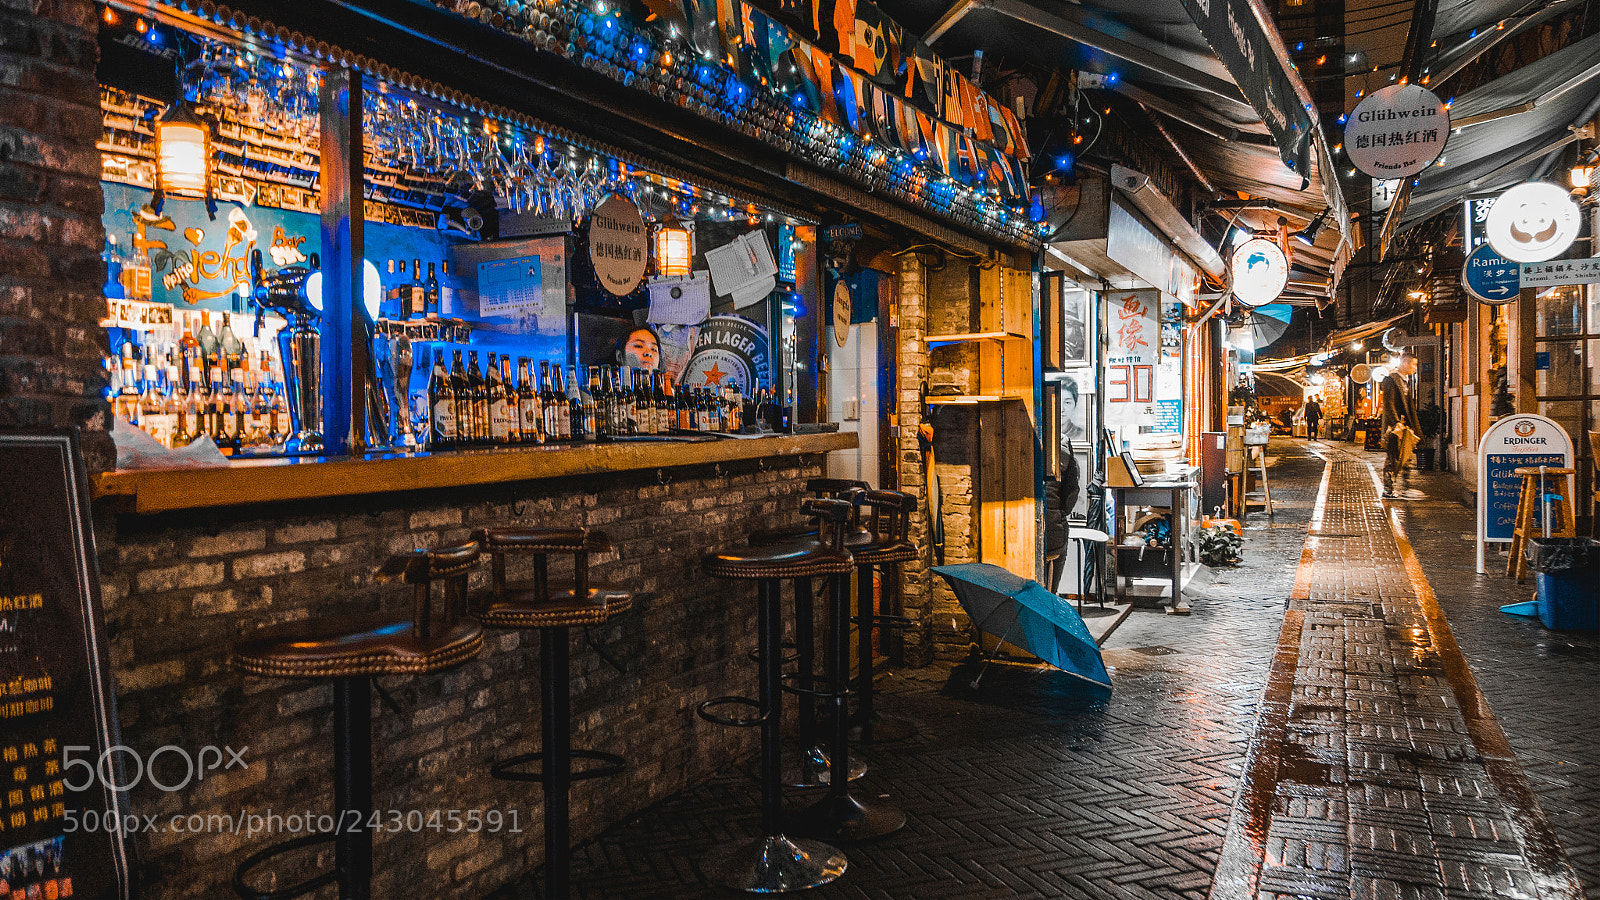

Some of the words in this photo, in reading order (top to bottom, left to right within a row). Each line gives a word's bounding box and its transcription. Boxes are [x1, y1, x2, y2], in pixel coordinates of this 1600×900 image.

[1357, 105, 1437, 123] Glühwein
[1355, 128, 1438, 149] 德国热红酒
[1373, 160, 1402, 170] Friends
[1402, 158, 1417, 168] Bar
[596, 215, 641, 234] Glühwein
[271, 226, 306, 249] Bar
[595, 241, 642, 262] 德国热红酒
[1473, 257, 1512, 268] Ramb
[716, 331, 756, 356] LAGER
[751, 352, 770, 389] BEER
[1109, 364, 1153, 403] 30
[1503, 437, 1547, 446] ERDINGER
[0, 593, 43, 612] 热红酒
